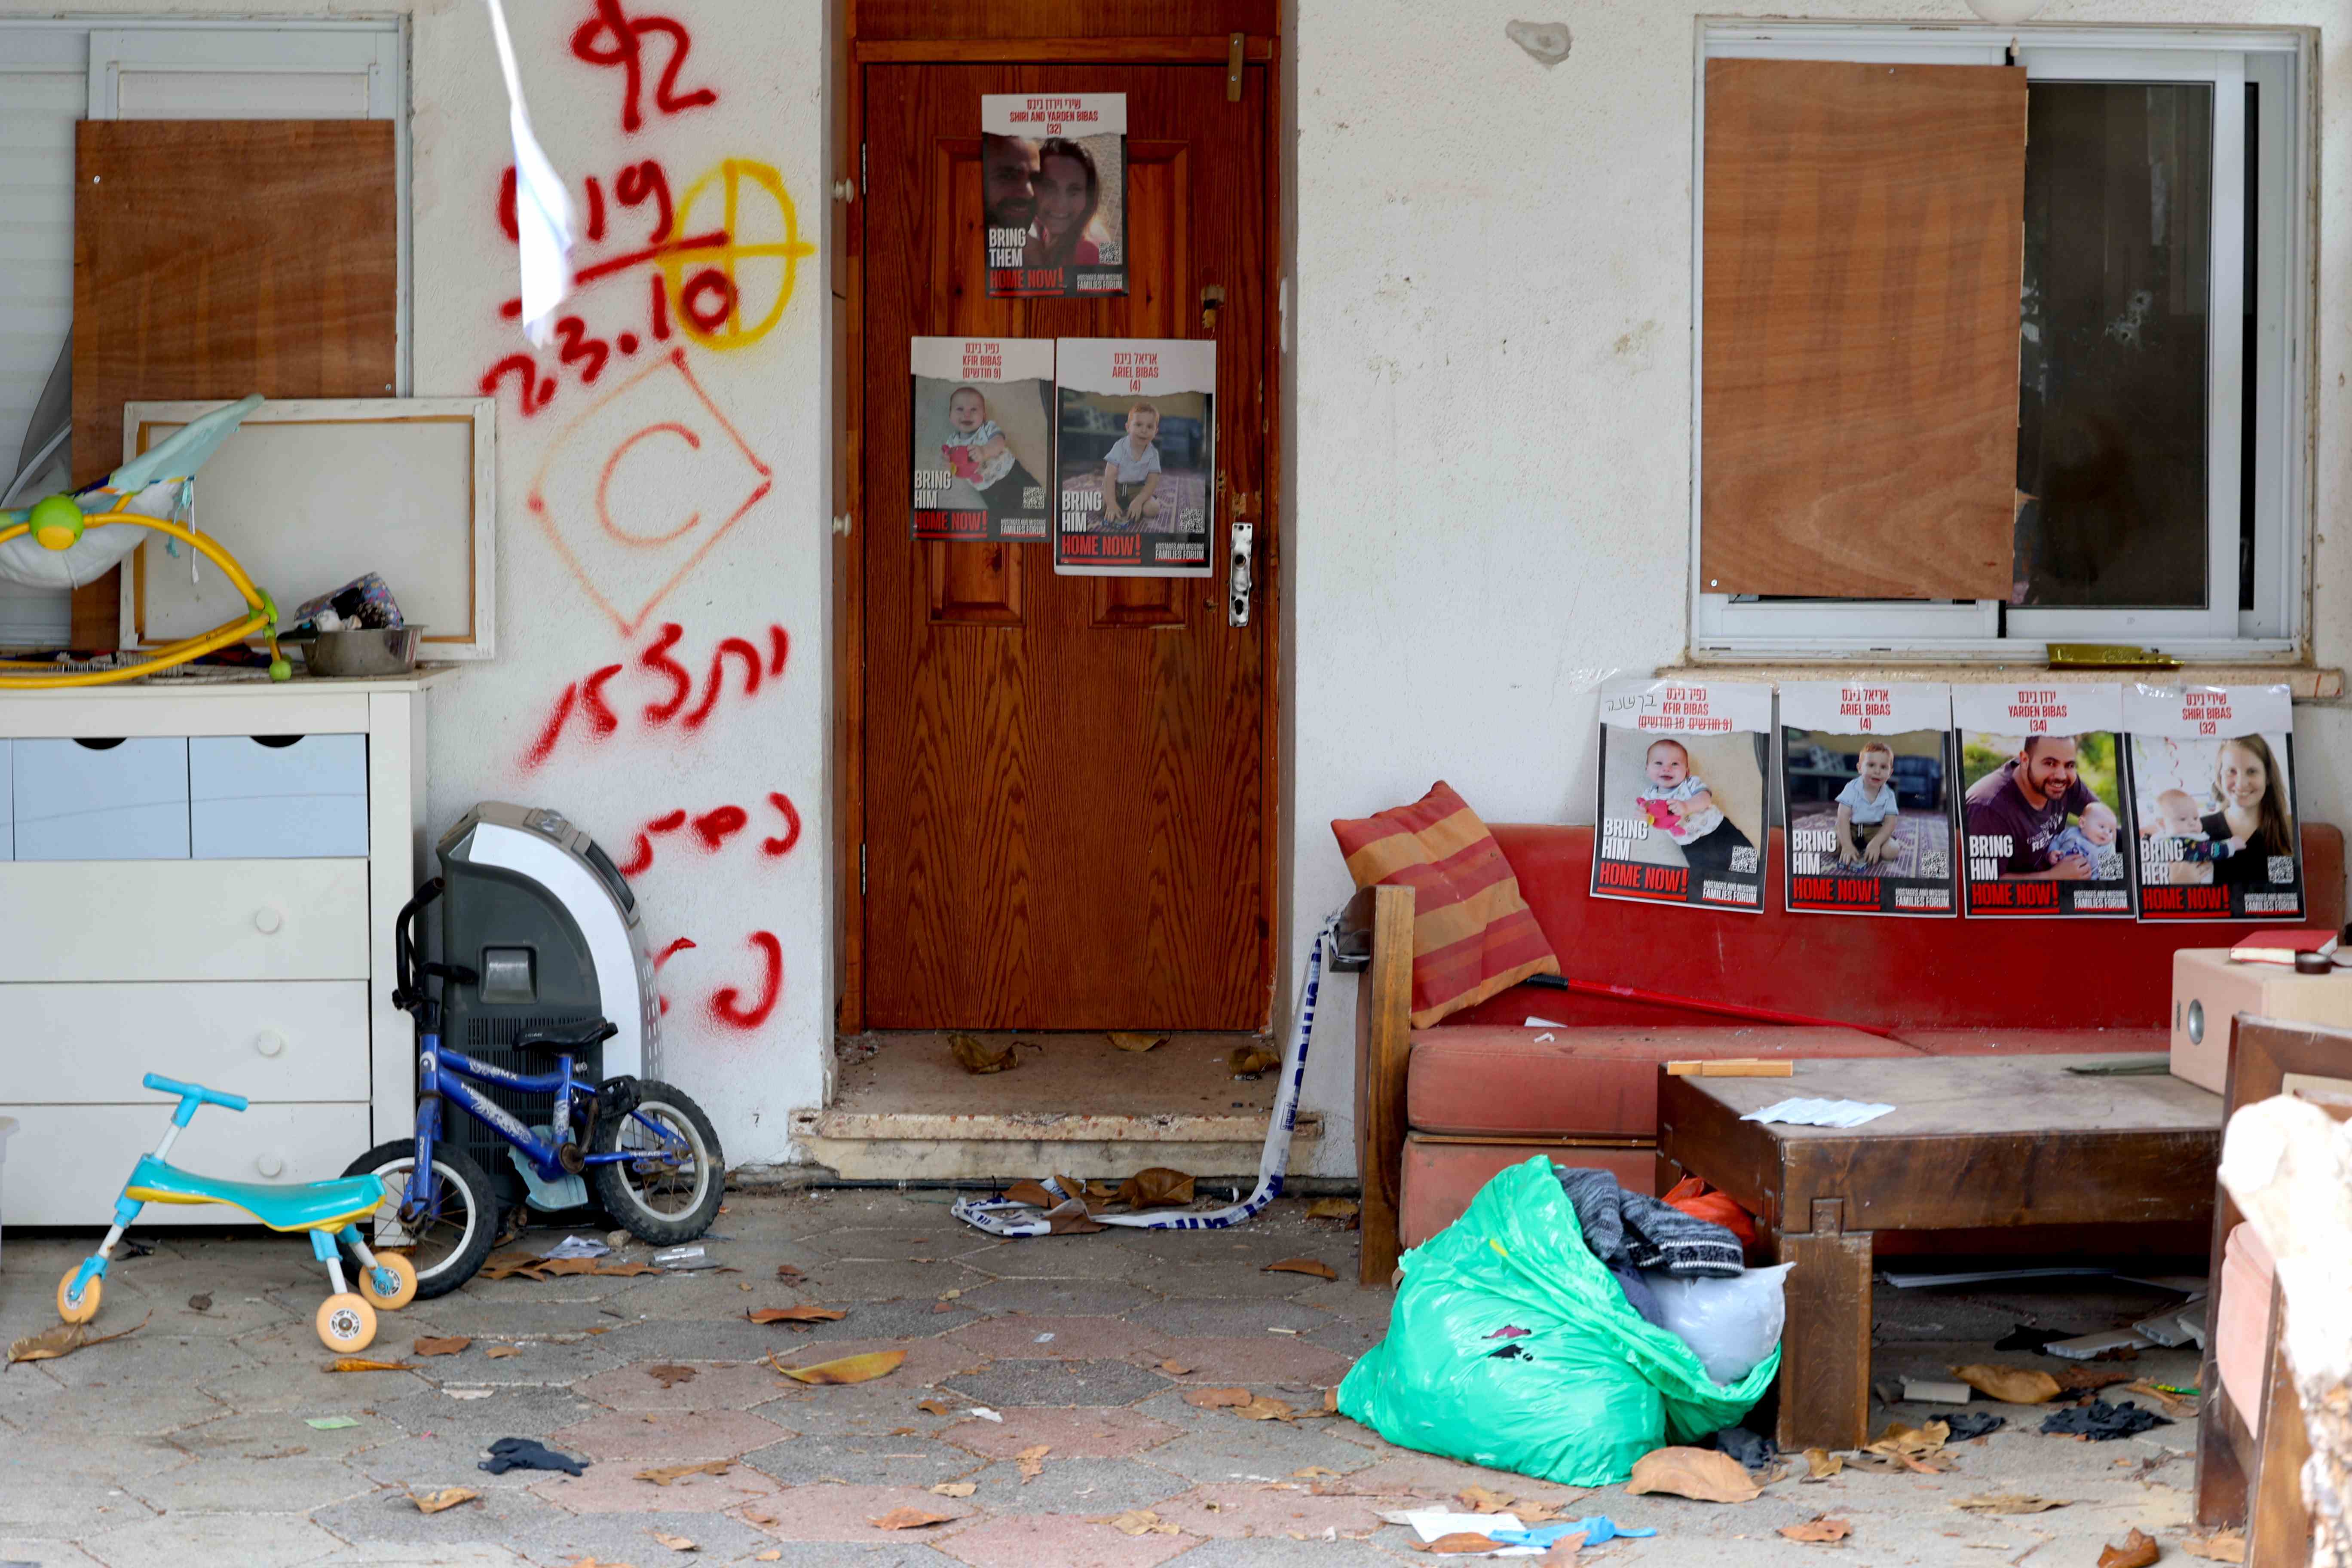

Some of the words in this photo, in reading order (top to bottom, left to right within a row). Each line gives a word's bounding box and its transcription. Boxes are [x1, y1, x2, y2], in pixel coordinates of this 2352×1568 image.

[1011, 111, 1028, 122] SHIRI
[1031, 111, 1045, 122] AND
[1047, 111, 1075, 121] YARDEN
[1077, 110, 1098, 121] BIBAS
[1047, 123, 1061, 135] (32)
[989, 228, 1026, 247] BRING
[989, 248, 1022, 267] THEM
[990, 270, 1023, 288] HOME
[1028, 267, 1063, 288] NOW!
[1077, 280, 1103, 289] FAMILIES
[1104, 280, 1122, 289] FORUM
[966, 343, 981, 353] ביבס
[984, 343, 999, 353] כפיר
[963, 355, 978, 365] KFIR
[980, 355, 1002, 365] BIBAS
[1114, 353, 1132, 365] ביבס
[1134, 353, 1157, 364] אריאל
[1112, 367, 1133, 378] ARIEL
[1136, 367, 1158, 378] BIBAS
[1130, 380, 1141, 392] (4)
[915, 471, 951, 489] BRING
[914, 490, 937, 509] HIM
[1062, 491, 1102, 511] BRING
[915, 511, 948, 530] HOME
[951, 510, 987, 530] NOW!
[1062, 512, 1087, 532] HIM
[1001, 526, 1025, 534] FAMILIES
[1026, 526, 1046, 534] FORUM
[1062, 535, 1098, 555] HOME
[1102, 534, 1141, 556] NOW!
[1186, 542, 1204, 551] MISSING
[1156, 550, 1182, 560] FAMILIES
[1183, 550, 1204, 560] FORUM
[1666, 688, 1685, 700] ביבס
[1689, 688, 1706, 700] כפיר
[1863, 689, 1888, 701] אריאל
[2018, 691, 2037, 704] ביבס
[2040, 691, 2056, 704] ירדן
[2187, 694, 2204, 705] ביבס
[2207, 693, 2226, 704] שירי
[1663, 702, 1681, 715] KFIR
[1684, 703, 1709, 716] BIBAS
[1840, 704, 1863, 715] ARIEL
[1865, 704, 1891, 715] BIBAS
[2008, 705, 2040, 717] YARDEN
[2043, 705, 2067, 717] BIBAS
[2182, 707, 2204, 720] SHIRI
[2207, 707, 2232, 719] BIBAS
[1860, 718, 1871, 730] (4)
[2030, 720, 2047, 732] (34)
[2199, 721, 2216, 735] (32)
[1603, 818, 1648, 840] BRING
[1792, 830, 1836, 852] BRING
[1969, 835, 2013, 858] BRING
[1602, 837, 1630, 861] HIM
[2140, 839, 2184, 862] BRING
[1792, 853, 1820, 875] HIM
[1970, 858, 1998, 880] HIM
[1599, 862, 1642, 888] HOME
[1645, 867, 1689, 893] NOW!
[2142, 862, 2169, 885] HER
[1703, 880, 1727, 890] HOSTAGES
[1727, 882, 1736, 891] AND
[1736, 883, 1757, 893] MISSING
[1793, 878, 1834, 900] HOME
[1838, 878, 1880, 902] NOW!
[1972, 883, 2012, 905] HOME
[2016, 881, 2059, 905] NOW!
[1703, 888, 1732, 901] FAMILIES
[1733, 892, 1757, 903] FORUM
[1895, 896, 1924, 907] FAMILIES
[1926, 897, 1949, 907] FORUM
[2142, 888, 2184, 910] HOME
[2187, 884, 2230, 910] NOW!
[2074, 898, 2103, 908] FAMILIES
[2104, 898, 2128, 908] FORUM
[2245, 901, 2274, 912] FAMILIES
[2275, 901, 2298, 912] FORUM
